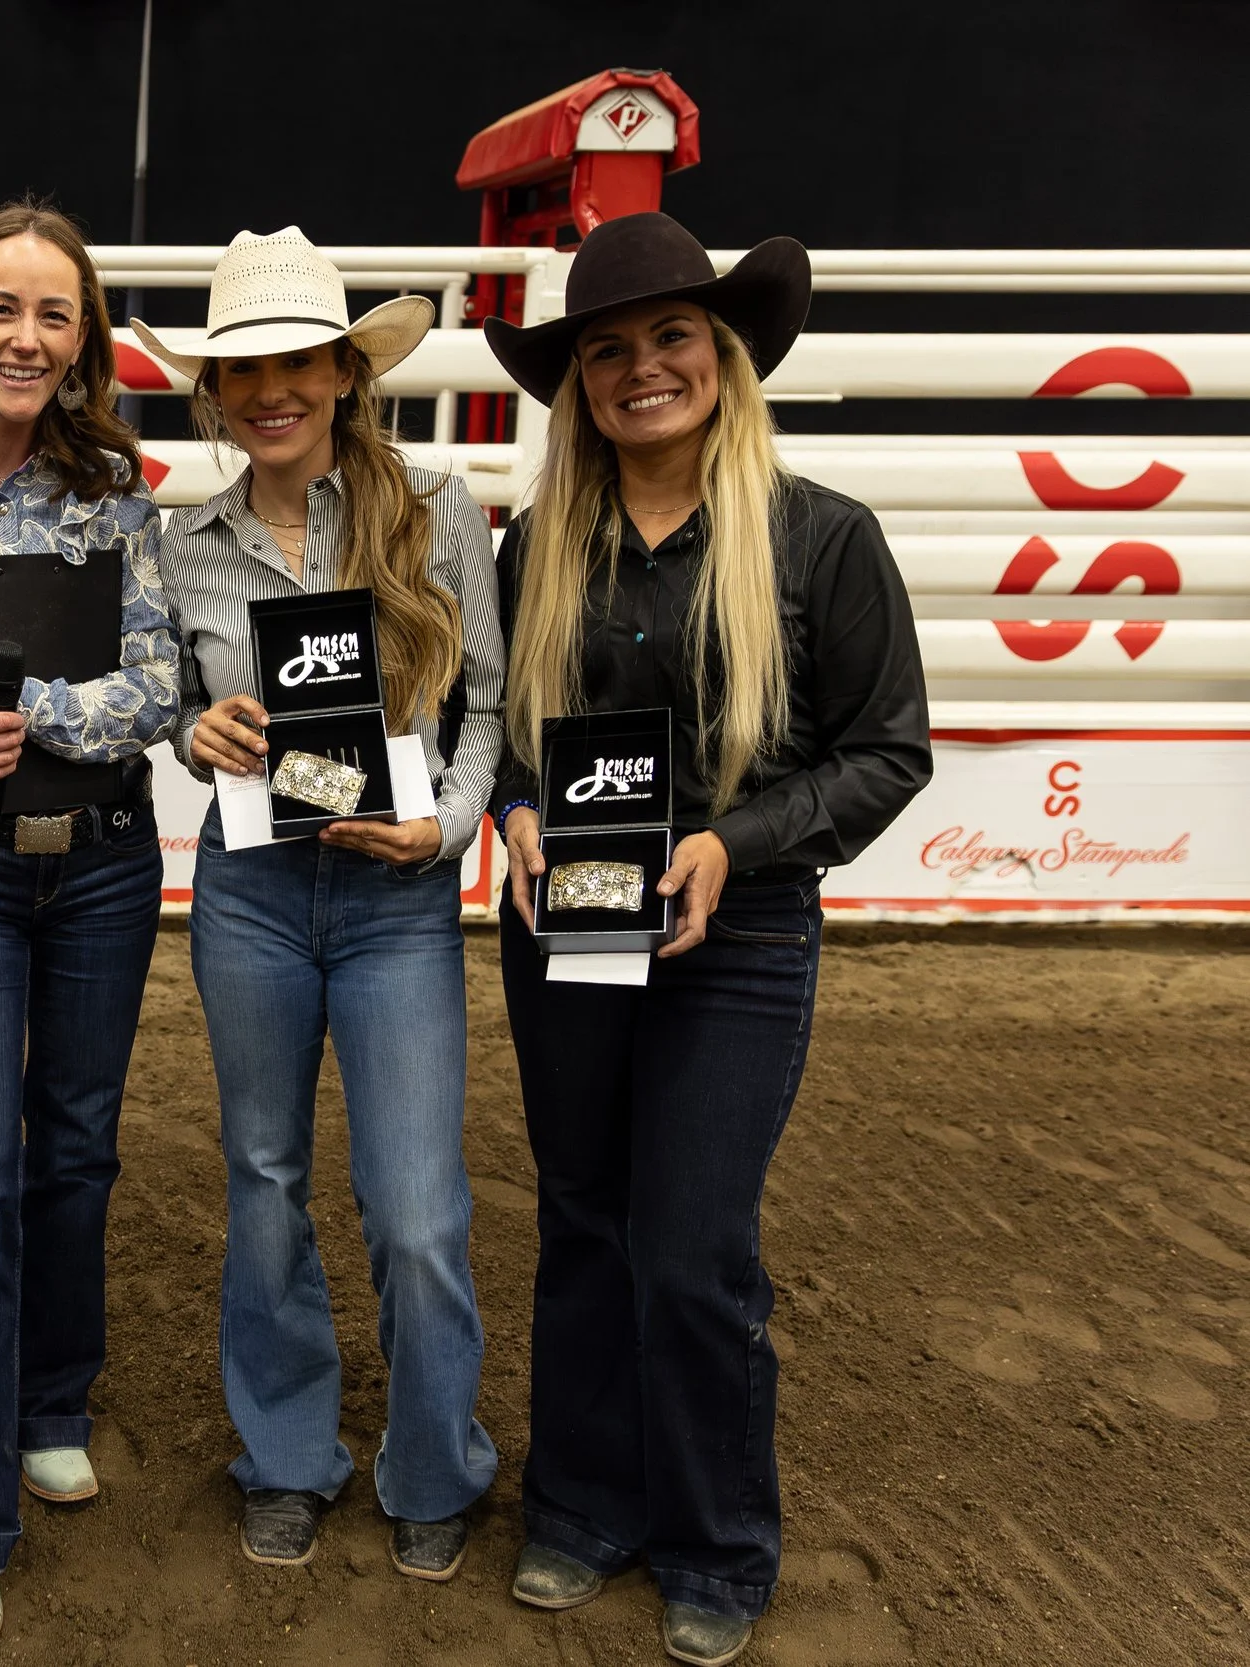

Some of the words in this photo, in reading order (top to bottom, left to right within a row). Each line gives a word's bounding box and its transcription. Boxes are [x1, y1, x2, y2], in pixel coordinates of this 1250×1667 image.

[618, 105, 642, 132] P
[321, 651, 360, 663] SILVER
[611, 773, 653, 783] SILVER
[112, 810, 132, 830] CH
[921, 826, 1039, 879] Calgary
[1039, 828, 1190, 878] Stampede
